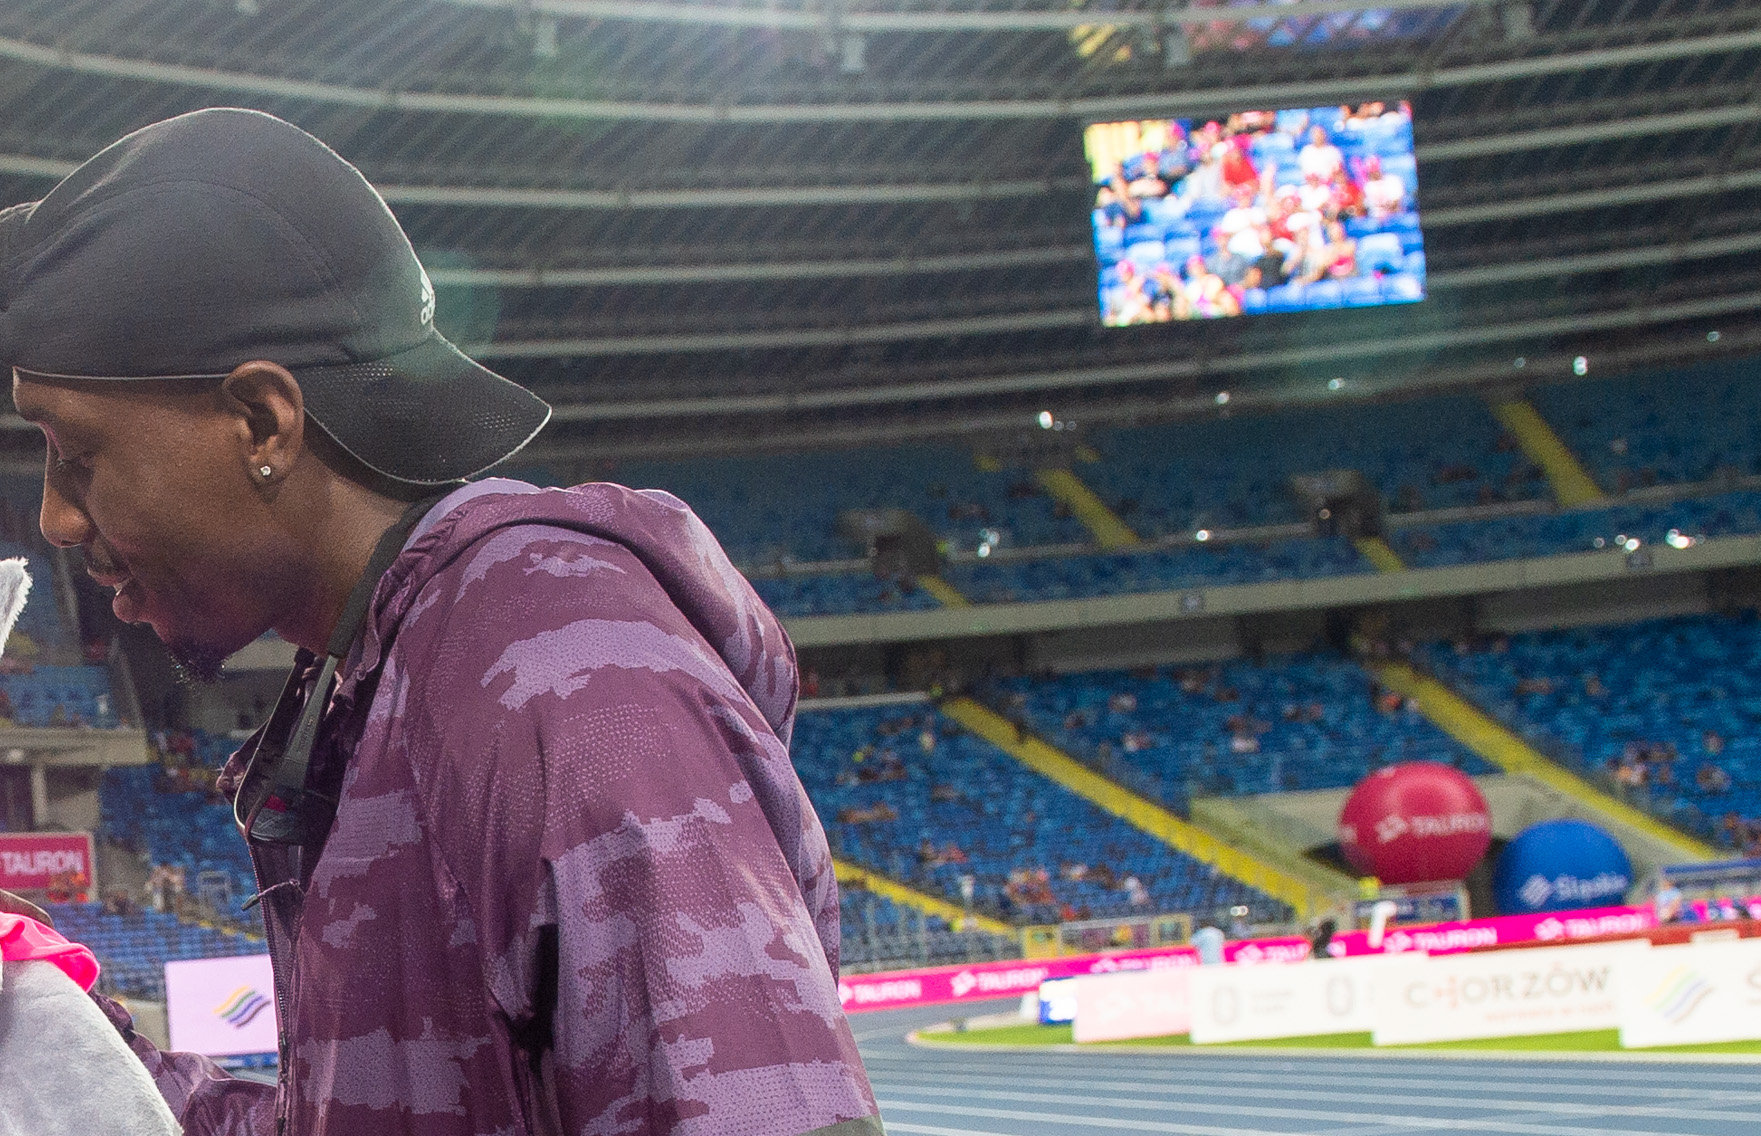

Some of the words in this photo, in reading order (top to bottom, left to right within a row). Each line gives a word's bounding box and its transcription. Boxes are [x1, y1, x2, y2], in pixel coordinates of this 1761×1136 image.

[1, 849, 84, 876] TAURON
[1411, 927, 1497, 951] TAURON
[852, 979, 922, 1004] TAURON
